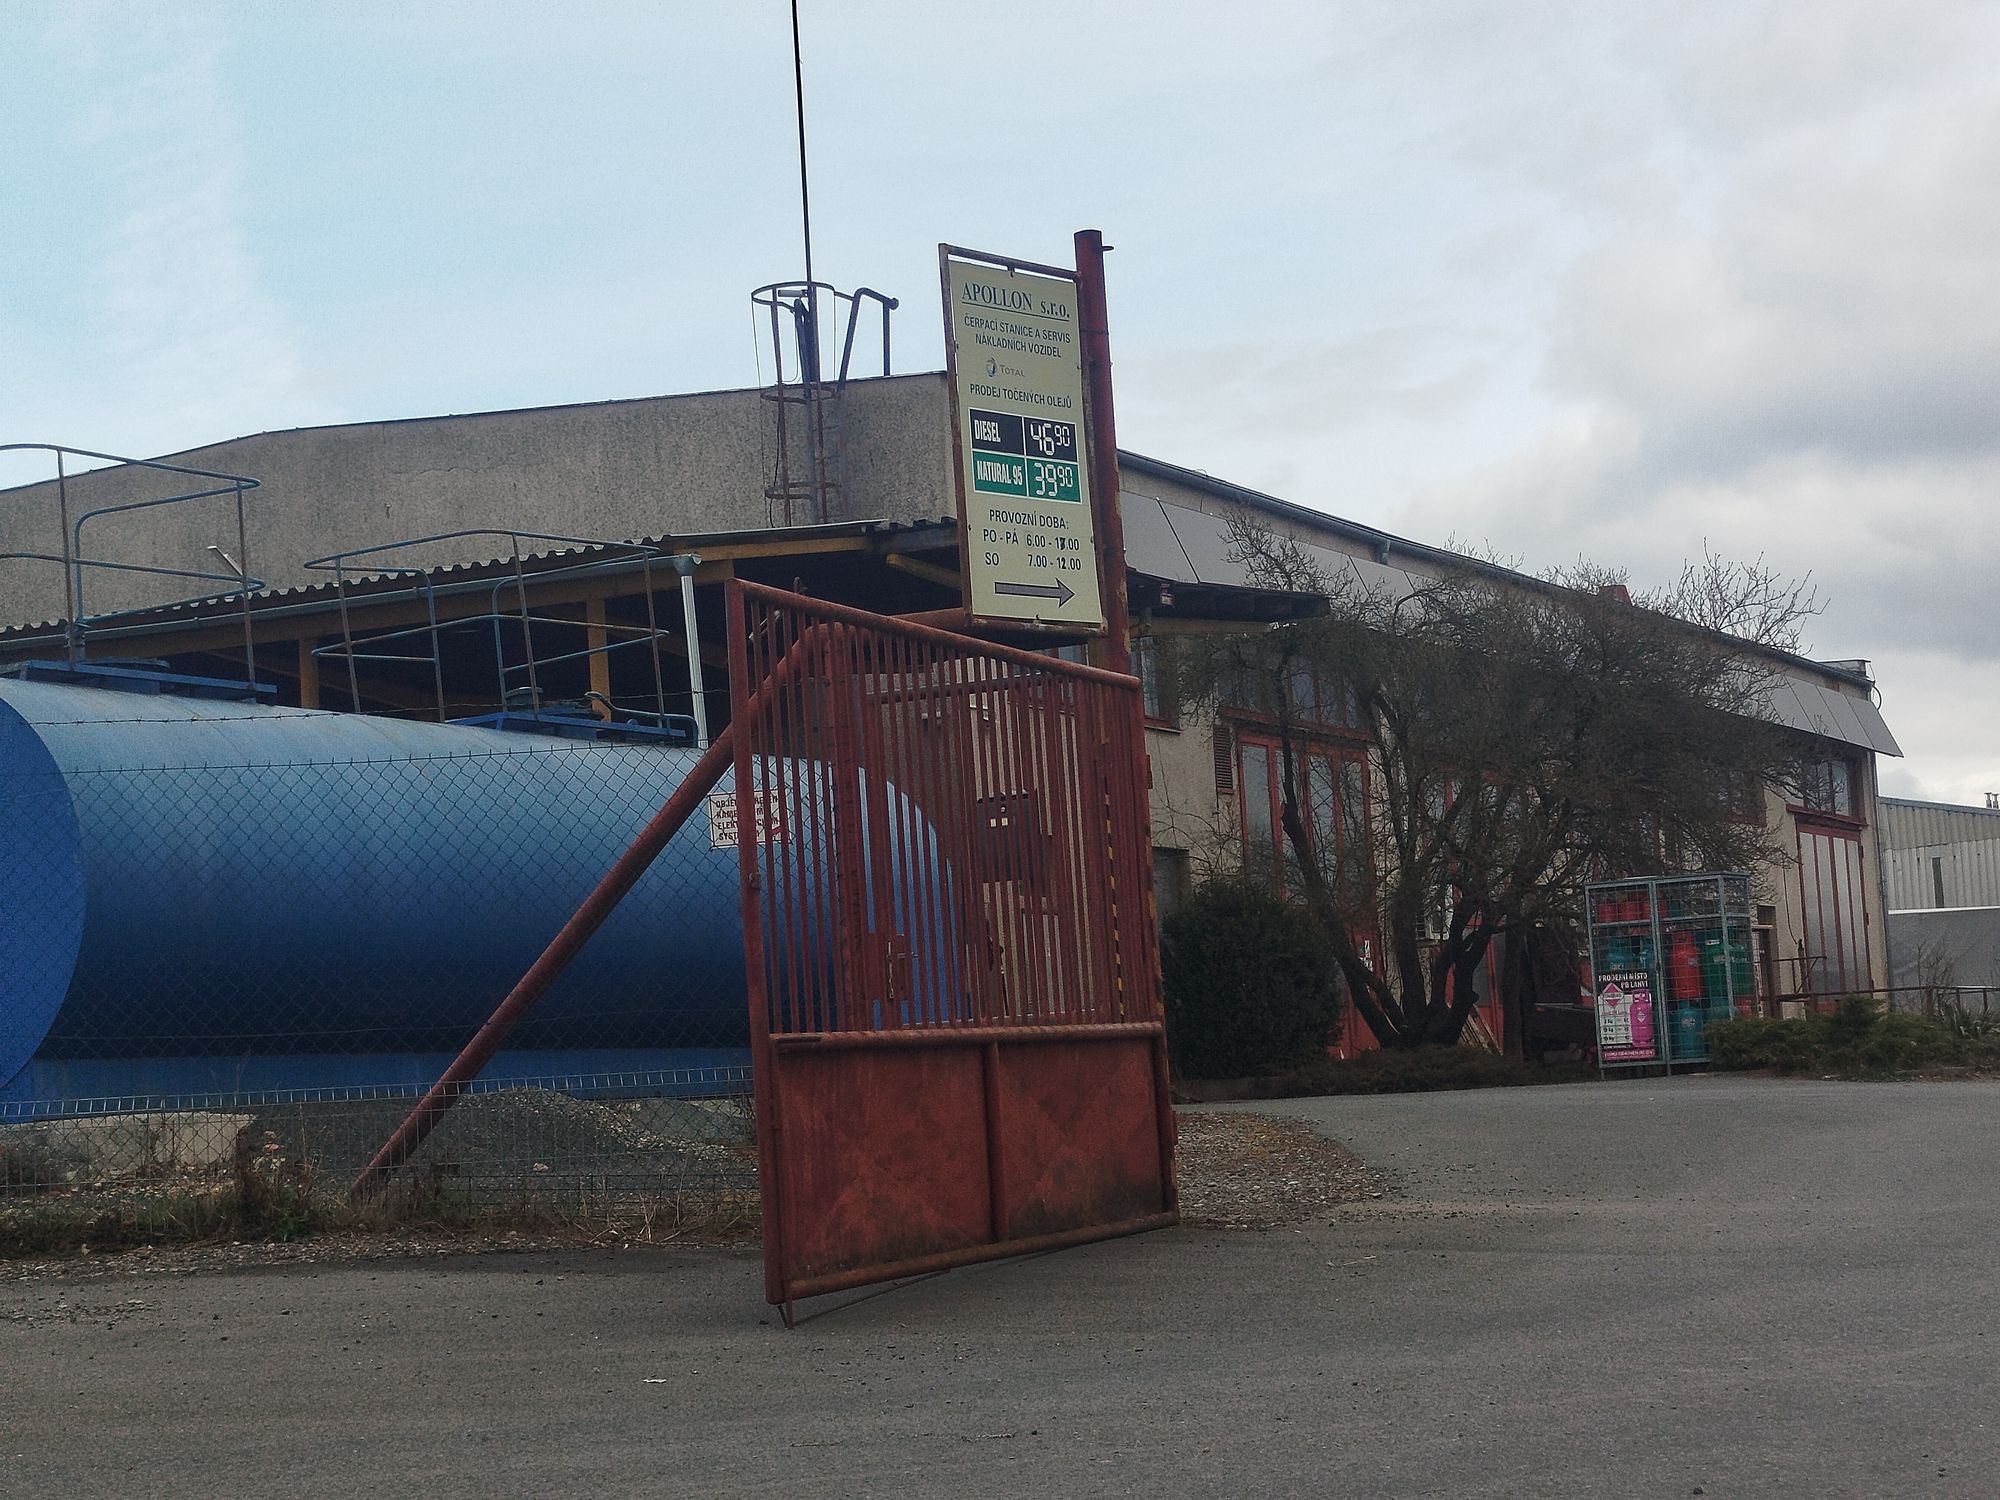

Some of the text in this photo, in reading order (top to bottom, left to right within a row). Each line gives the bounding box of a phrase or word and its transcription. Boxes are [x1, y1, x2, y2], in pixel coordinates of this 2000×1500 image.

[962, 282, 1070, 318] APOLLON s.r.o.
[964, 313, 1071, 344] ČERPACÍ STANICE A SERVIS
[975, 332, 1062, 358] NÁKLADNÍCH VOZIDEL
[970, 383, 1072, 409] PRODEJ TOČENÝCH OLEJŮ
[974, 419, 1001, 443] DIESEL
[976, 460, 1011, 485] NATURAL
[1012, 466, 1024, 486] 95
[989, 509, 1069, 530] PROVOZNÍ DOBA:
[983, 529, 997, 543] PO
[1005, 528, 1019, 545] PÁ
[1026, 535, 1046, 548] 6.00
[985, 552, 1000, 566] SO
[1028, 555, 1047, 568] 7.00
[1056, 557, 1081, 571] 12.00
